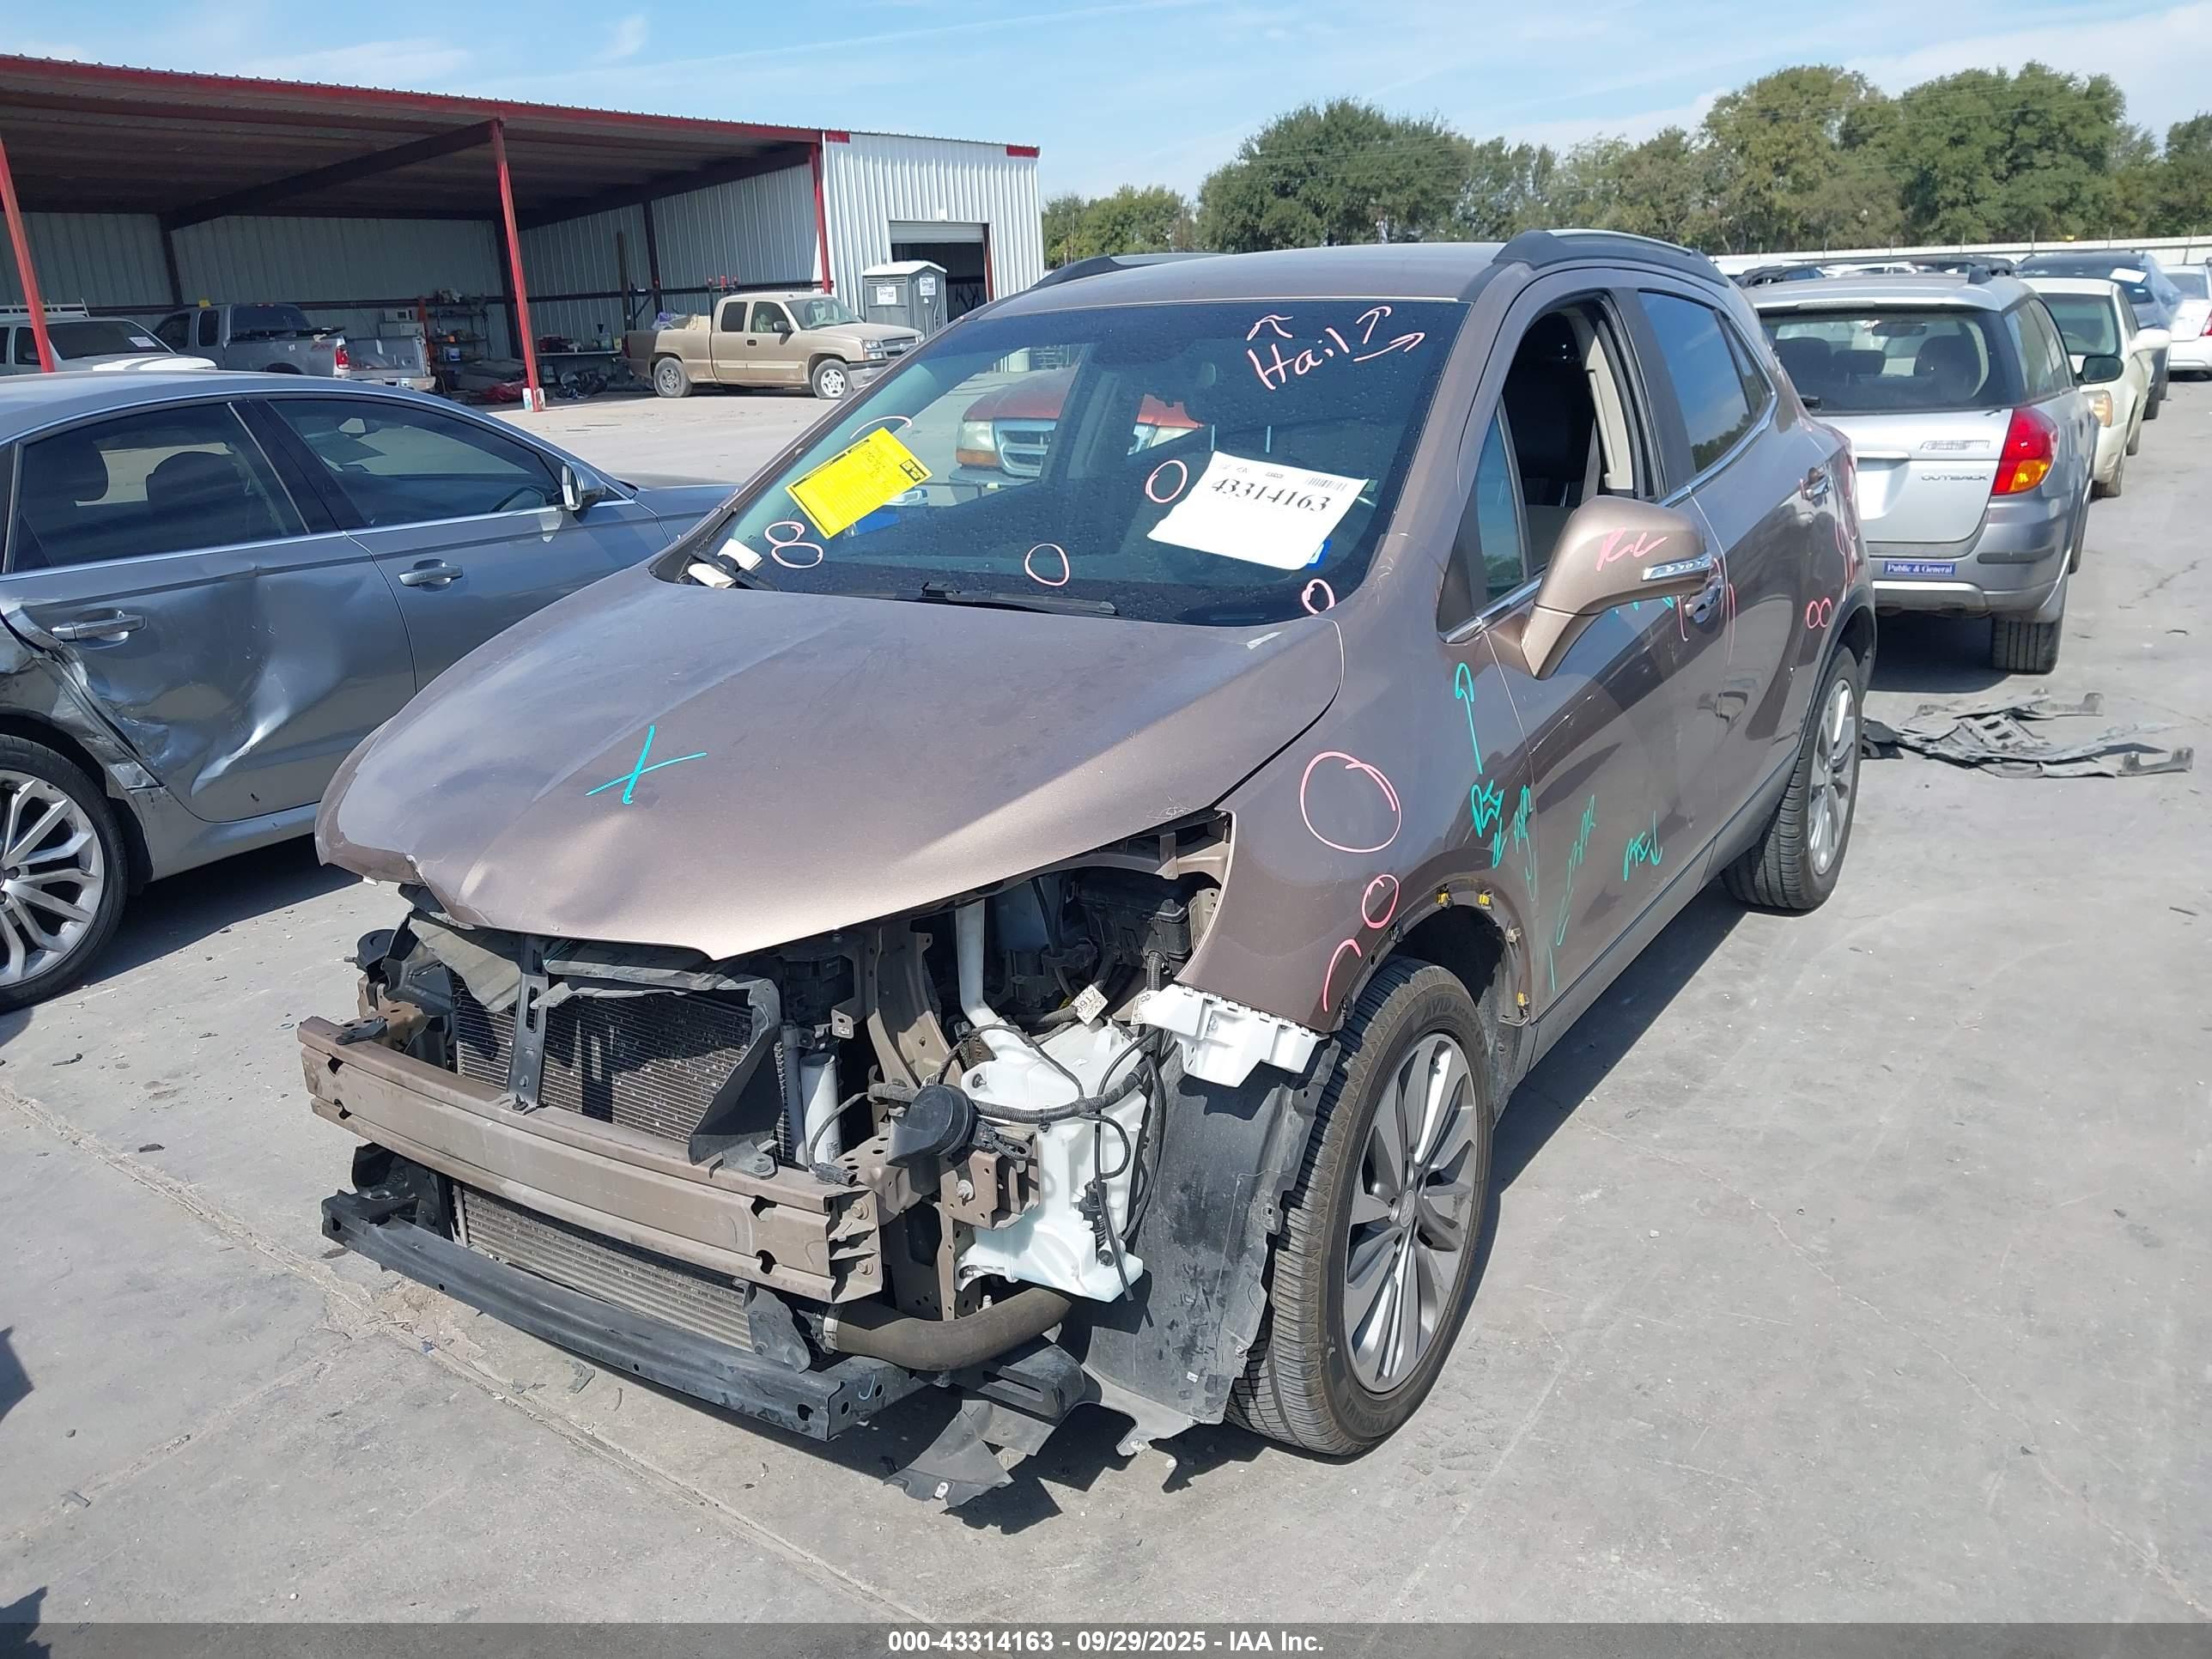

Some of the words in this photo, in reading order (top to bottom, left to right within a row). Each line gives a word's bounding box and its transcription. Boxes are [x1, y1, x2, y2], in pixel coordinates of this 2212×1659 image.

[1247, 327, 1351, 390] Hail
[1212, 477, 1331, 513] 43314163
[1887, 563, 1911, 574] Public
[1913, 564, 1920, 574] &
[1921, 564, 1953, 574] General
